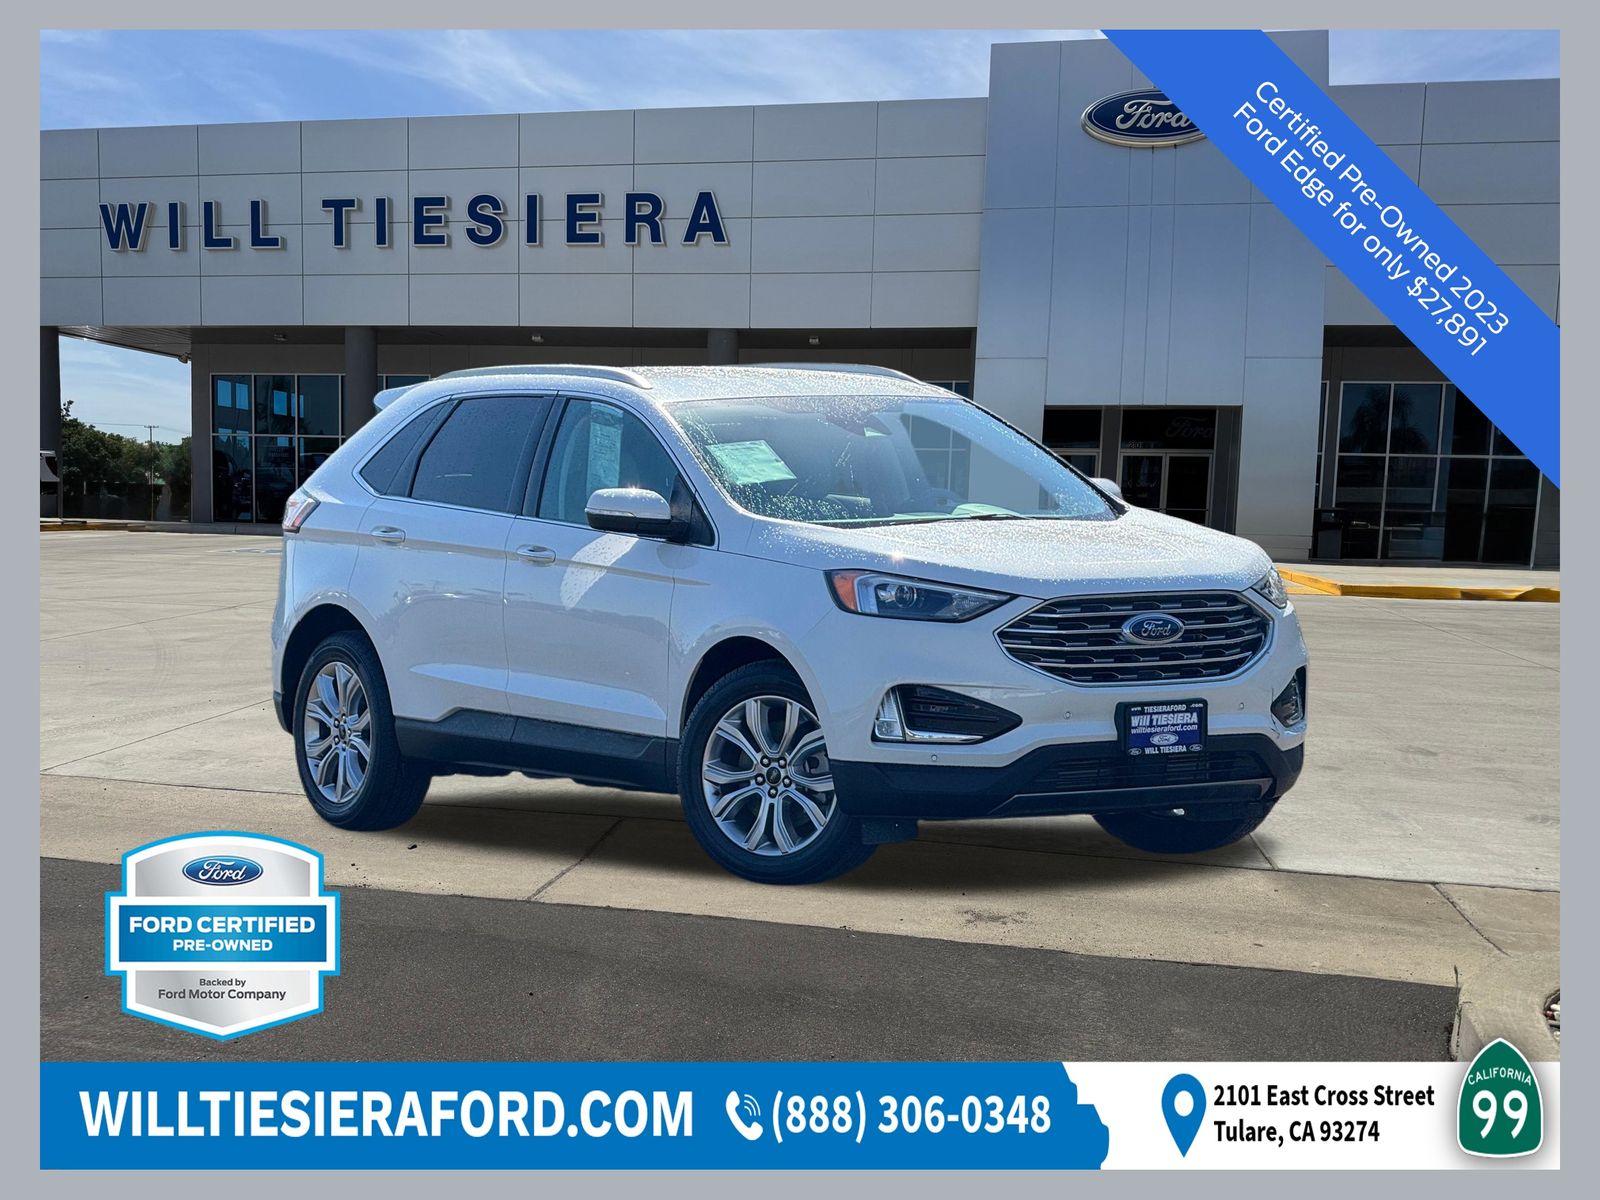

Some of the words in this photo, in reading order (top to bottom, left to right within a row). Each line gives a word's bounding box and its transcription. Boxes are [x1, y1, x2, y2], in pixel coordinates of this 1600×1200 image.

[99, 199, 285, 251] WILL
[321, 190, 730, 248] TIESIERA
[1141, 620, 1171, 636] Ford
[1144, 704, 1187, 713] TIESIERAFORD
[1131, 714, 1150, 727] Will
[1151, 712, 1198, 726] TIESIERA
[1131, 724, 1198, 734] willtiesieraford.com
[1144, 746, 1159, 754] WILL
[1160, 745, 1187, 753] TIESIERA
